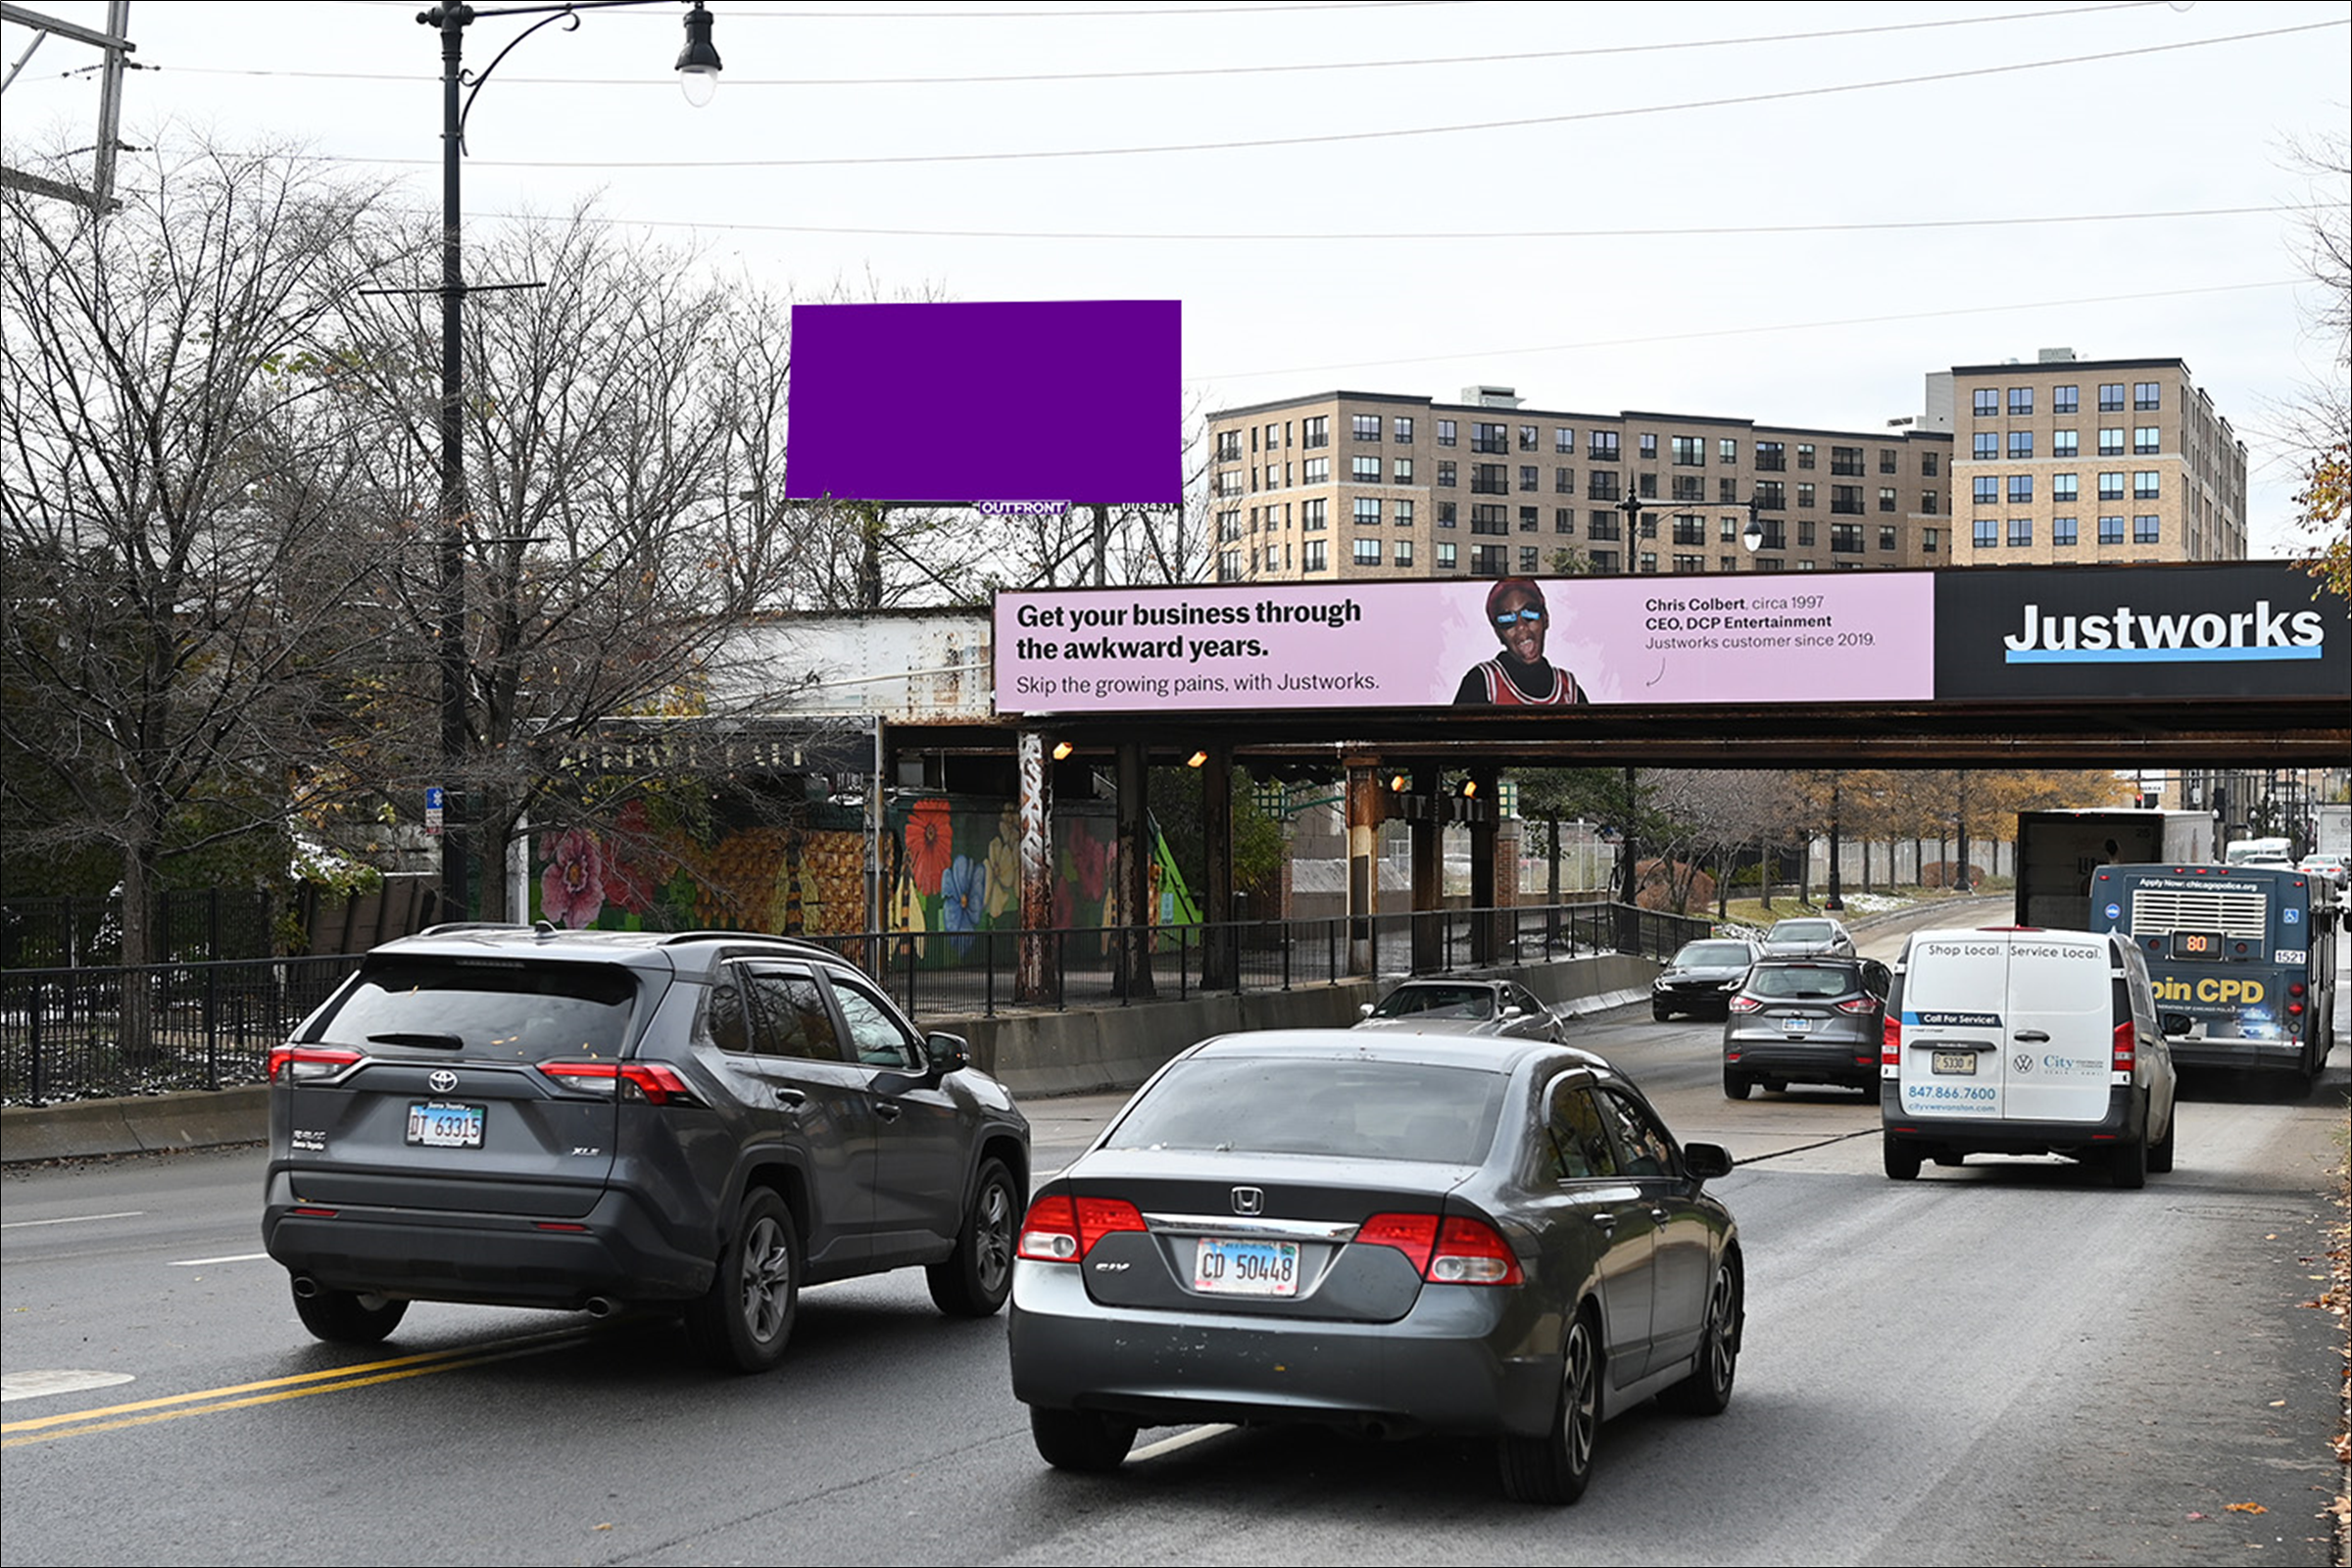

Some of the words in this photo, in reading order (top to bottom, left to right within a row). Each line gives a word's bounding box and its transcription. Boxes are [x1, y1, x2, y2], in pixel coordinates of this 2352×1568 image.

[981, 502, 1066, 514] OUTFRONT
[1645, 598, 1686, 612] Chris
[1689, 597, 1748, 611] Colbert,
[1751, 596, 1788, 610] circa
[1791, 595, 1824, 610] 1997
[1017, 604, 1064, 627] Get
[1069, 610, 1127, 632] your
[1133, 603, 1250, 626] business
[1255, 599, 1361, 628] through
[1645, 617, 1683, 631] CEO,
[1686, 616, 1721, 630] DCP
[1724, 615, 1832, 629] Entertainment
[2004, 602, 2325, 652] Justworks
[1016, 637, 1058, 660] the
[1063, 635, 1183, 660] awkward
[1189, 639, 1268, 662] years.
[1645, 636, 1719, 650] Justworks
[1722, 635, 1790, 649] customer
[1794, 634, 1834, 647] since
[1838, 633, 1876, 647] 2019.
[1016, 675, 1056, 697] Skip
[1062, 676, 1091, 693] the
[1095, 675, 1169, 698] growing
[1174, 674, 1229, 696] pains,
[1234, 673, 1272, 691] with
[1277, 672, 1380, 691] Justworks.
[2139, 878, 2163, 889] Apply
[2186, 880, 2258, 892] chicagopolice.org
[1929, 945, 1961, 956] Shop
[1965, 945, 2002, 956] Local.
[2010, 946, 2058, 957] Service
[2063, 947, 2101, 959] Local.
[2186, 936, 2207, 952] 80
[2277, 952, 2304, 962] 1521
[2151, 977, 2191, 1001] oin
[2196, 978, 2265, 1004] CPD
[1924, 1014, 1941, 1023] Call
[1959, 1015, 1995, 1024] Service!
[2043, 1054, 2074, 1070] City
[1908, 1087, 1995, 1100] 847.866.7600
[410, 1115, 427, 1135] DT
[435, 1116, 480, 1138] 63315
[1202, 1252, 1225, 1278] CD
[1237, 1254, 1293, 1282] 50448
